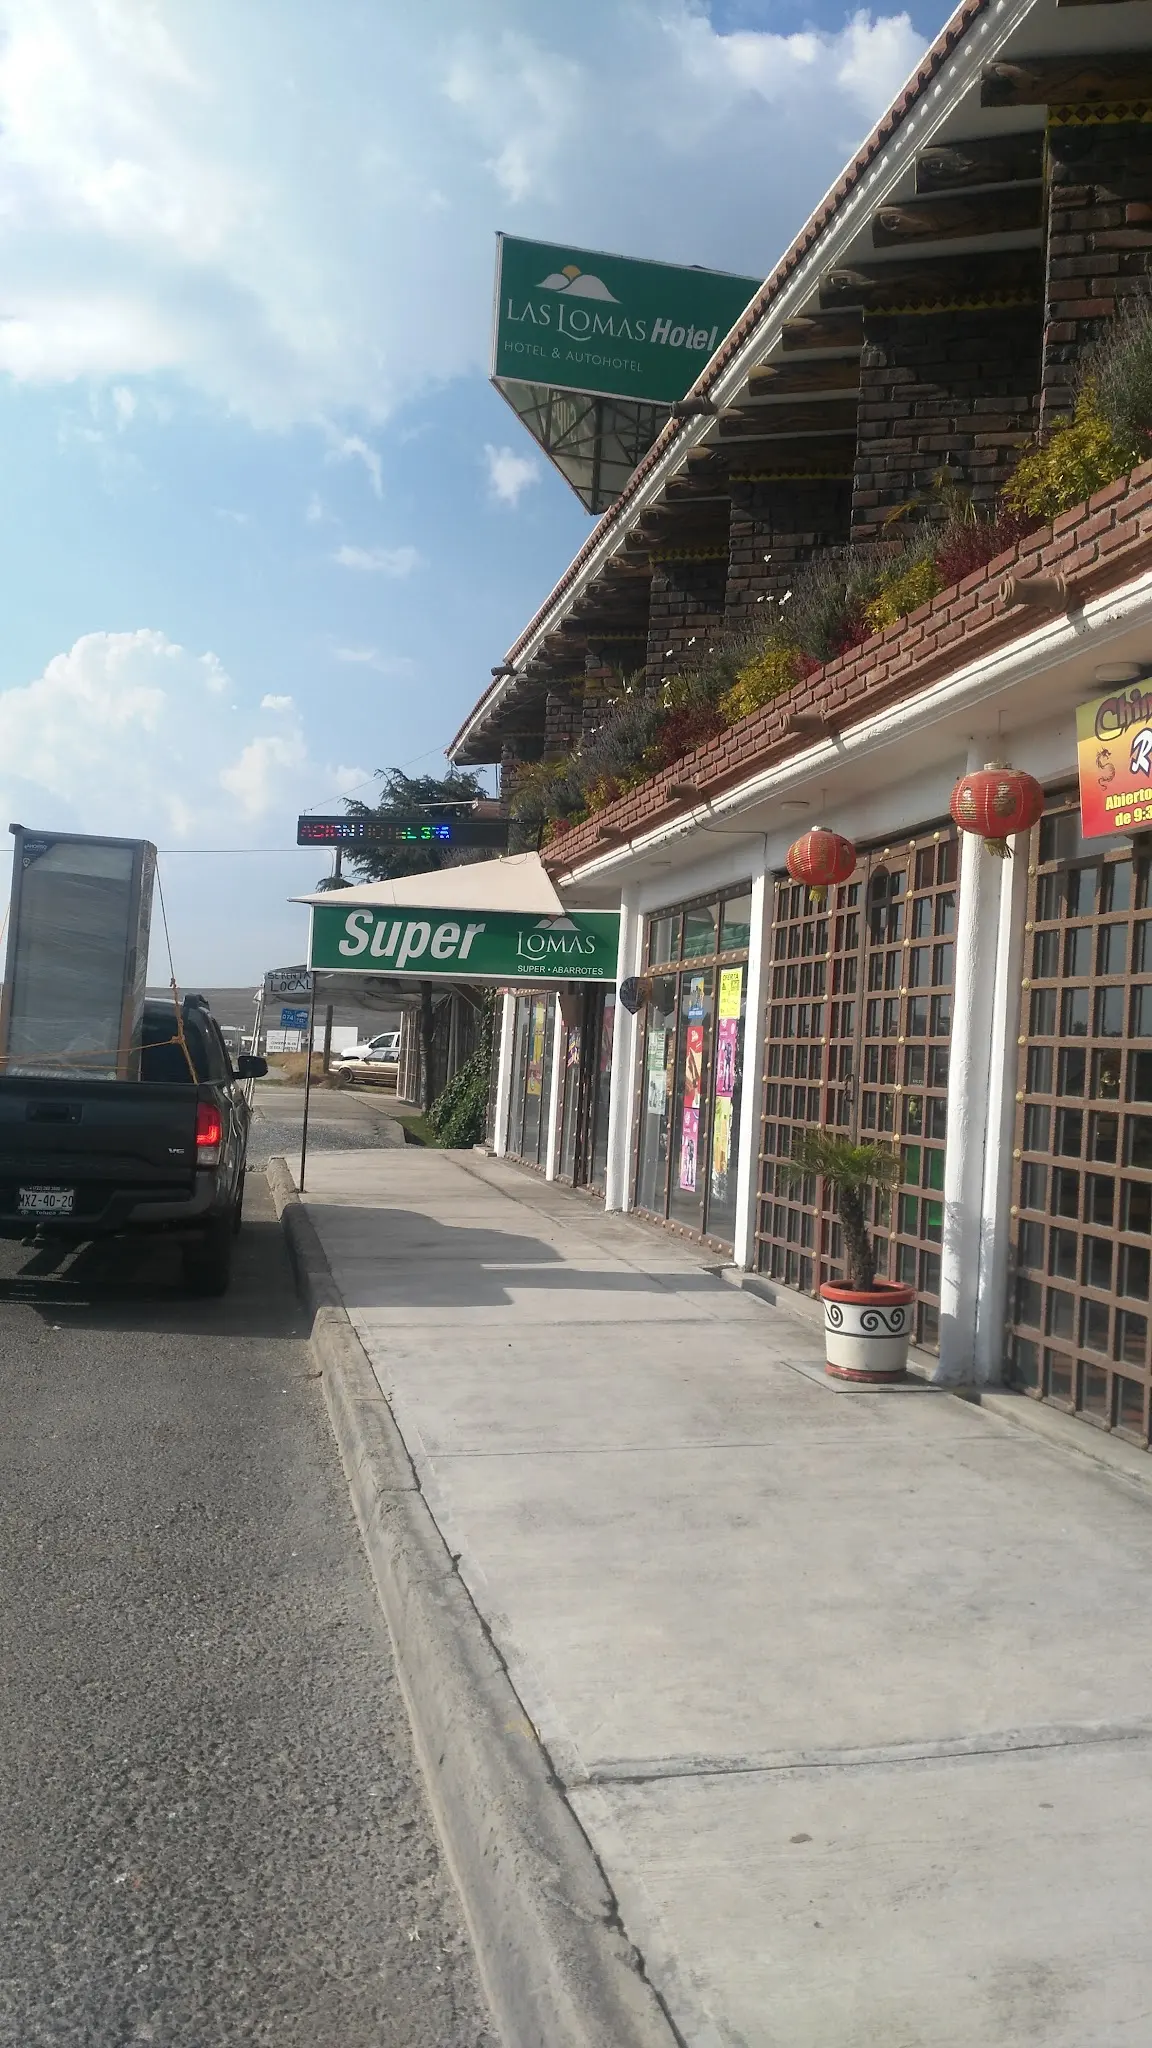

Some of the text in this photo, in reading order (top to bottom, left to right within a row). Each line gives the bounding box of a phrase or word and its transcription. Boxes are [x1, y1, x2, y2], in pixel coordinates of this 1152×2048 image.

[507, 298, 719, 351] LAS LOMAS Hotel
[504, 340, 643, 373] HOTEL & AUTOHOTEL
[1115, 811, 1131, 826] de
[338, 909, 486, 968] Super
[516, 931, 596, 961] LOMAS
[517, 964, 604, 976] SUPER ABARROTES
[270, 979, 312, 992] LOCAL
